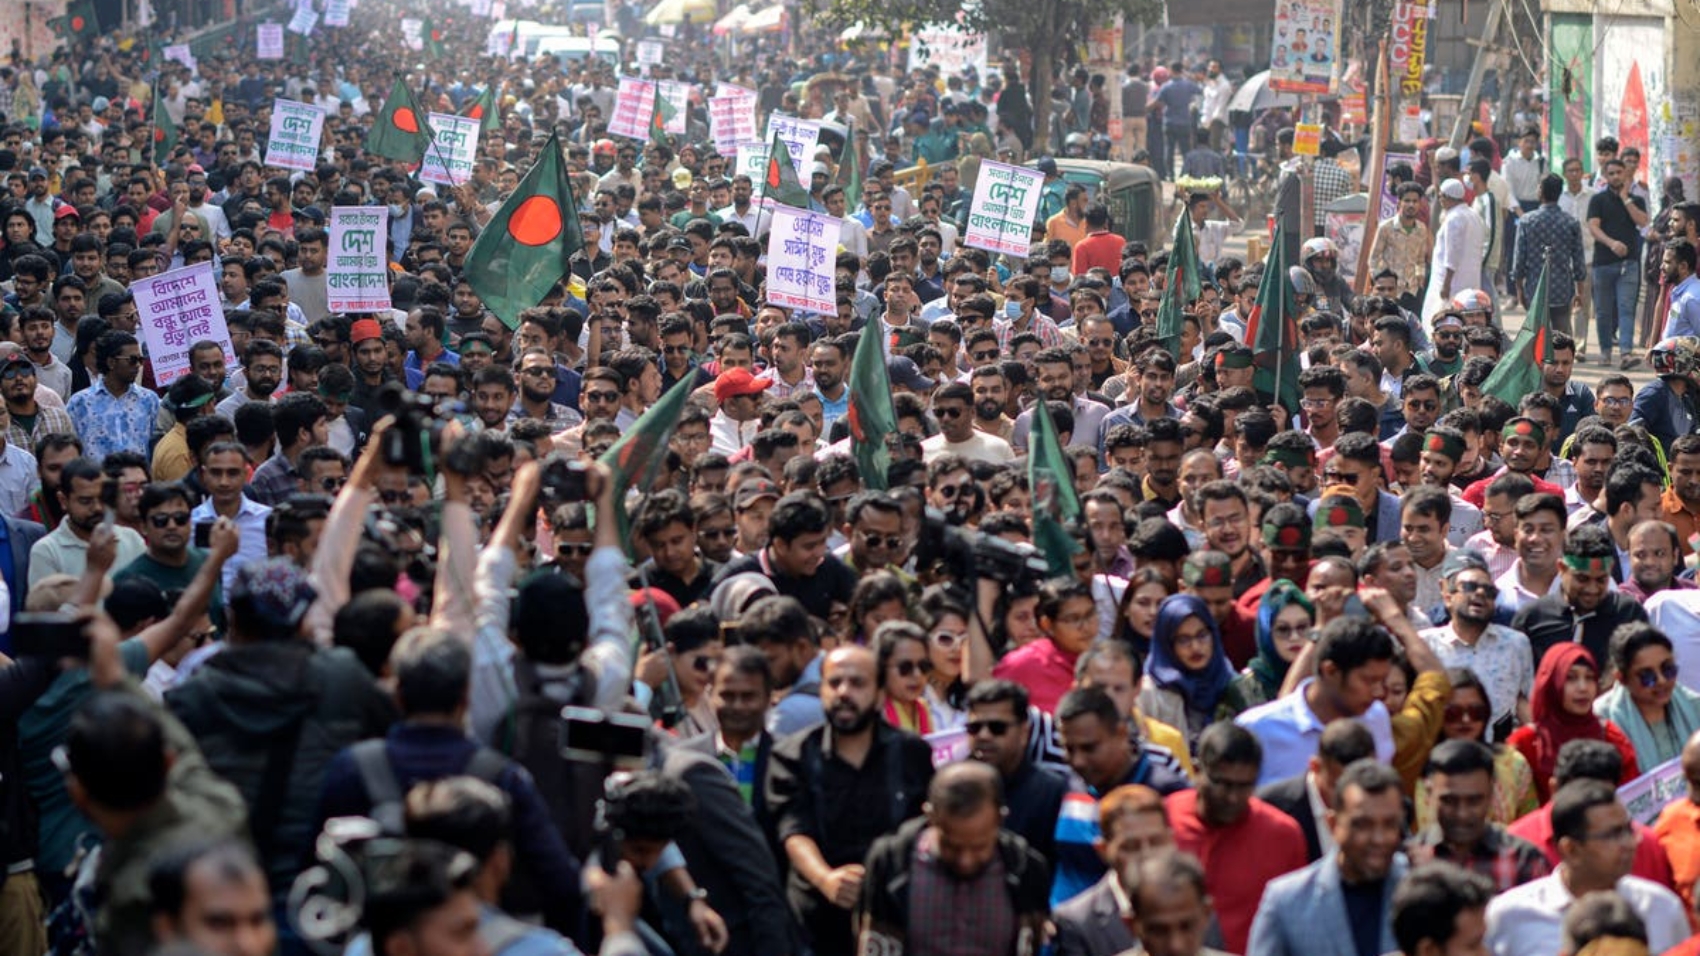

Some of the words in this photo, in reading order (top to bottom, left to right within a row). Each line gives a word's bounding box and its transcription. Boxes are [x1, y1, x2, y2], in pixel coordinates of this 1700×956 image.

[283, 116, 312, 133] দেশ
[270, 141, 316, 157] বাংলাদেশ
[438, 130, 467, 148] দেশ
[989, 182, 1028, 206] দেশ
[970, 214, 1030, 238] বাংলাদেশ
[342, 229, 376, 252] দেশ
[151, 274, 197, 297] বিদেশে
[328, 272, 386, 288] বাংলাদেশ
[150, 289, 207, 314] আমাদের
[152, 314, 178, 331] বন্ধু
[178, 304, 213, 324] আছে
[163, 330, 186, 346] প্রভু
[188, 320, 212, 338] নেই
